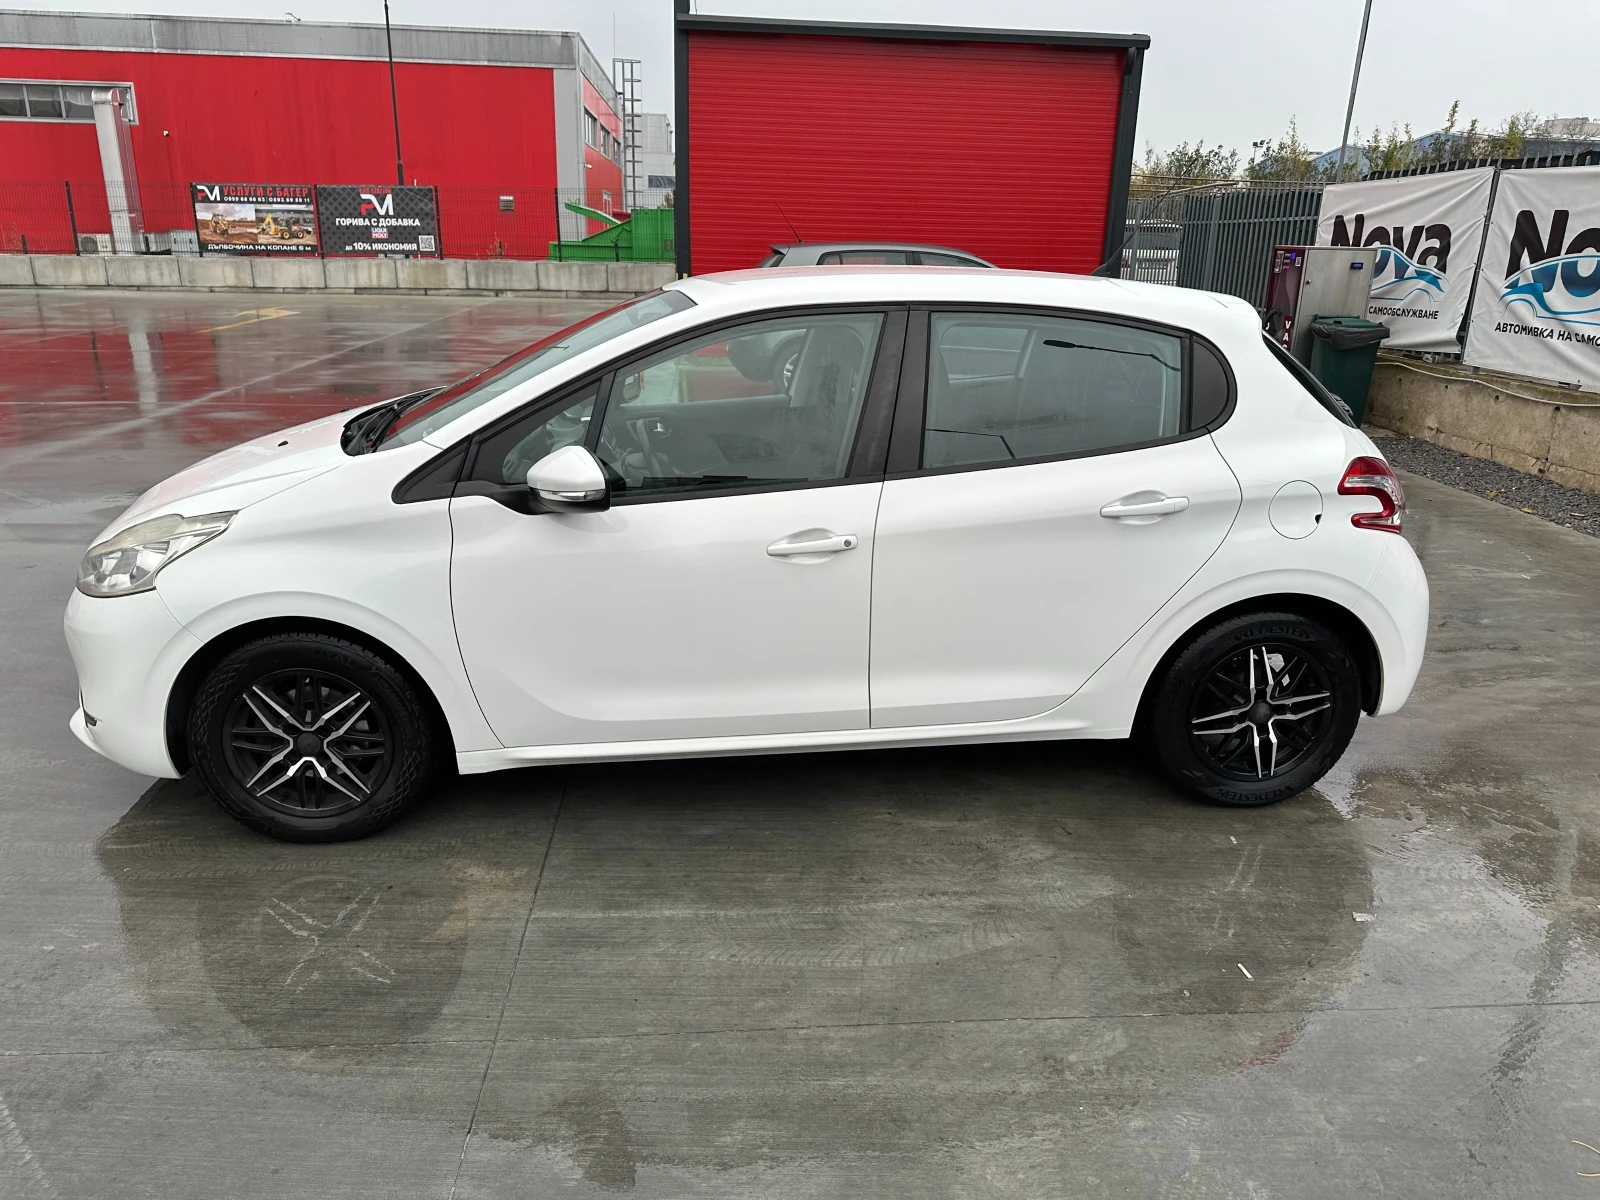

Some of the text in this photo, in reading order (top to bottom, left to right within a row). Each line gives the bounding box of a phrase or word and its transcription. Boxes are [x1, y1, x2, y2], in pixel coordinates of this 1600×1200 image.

[222, 186, 308, 198] УСЛУГИ С БАГЕР
[336, 218, 420, 227] ГОРИВА С ДОБАВКА
[353, 242, 372, 250] 10%
[372, 243, 418, 251] ИКОНОМИЯ
[1368, 305, 1440, 320] САМООБСЛУЖВАНЕ
[1495, 322, 1554, 340] АВТОМИВКА
[1556, 330, 1572, 342] НА
